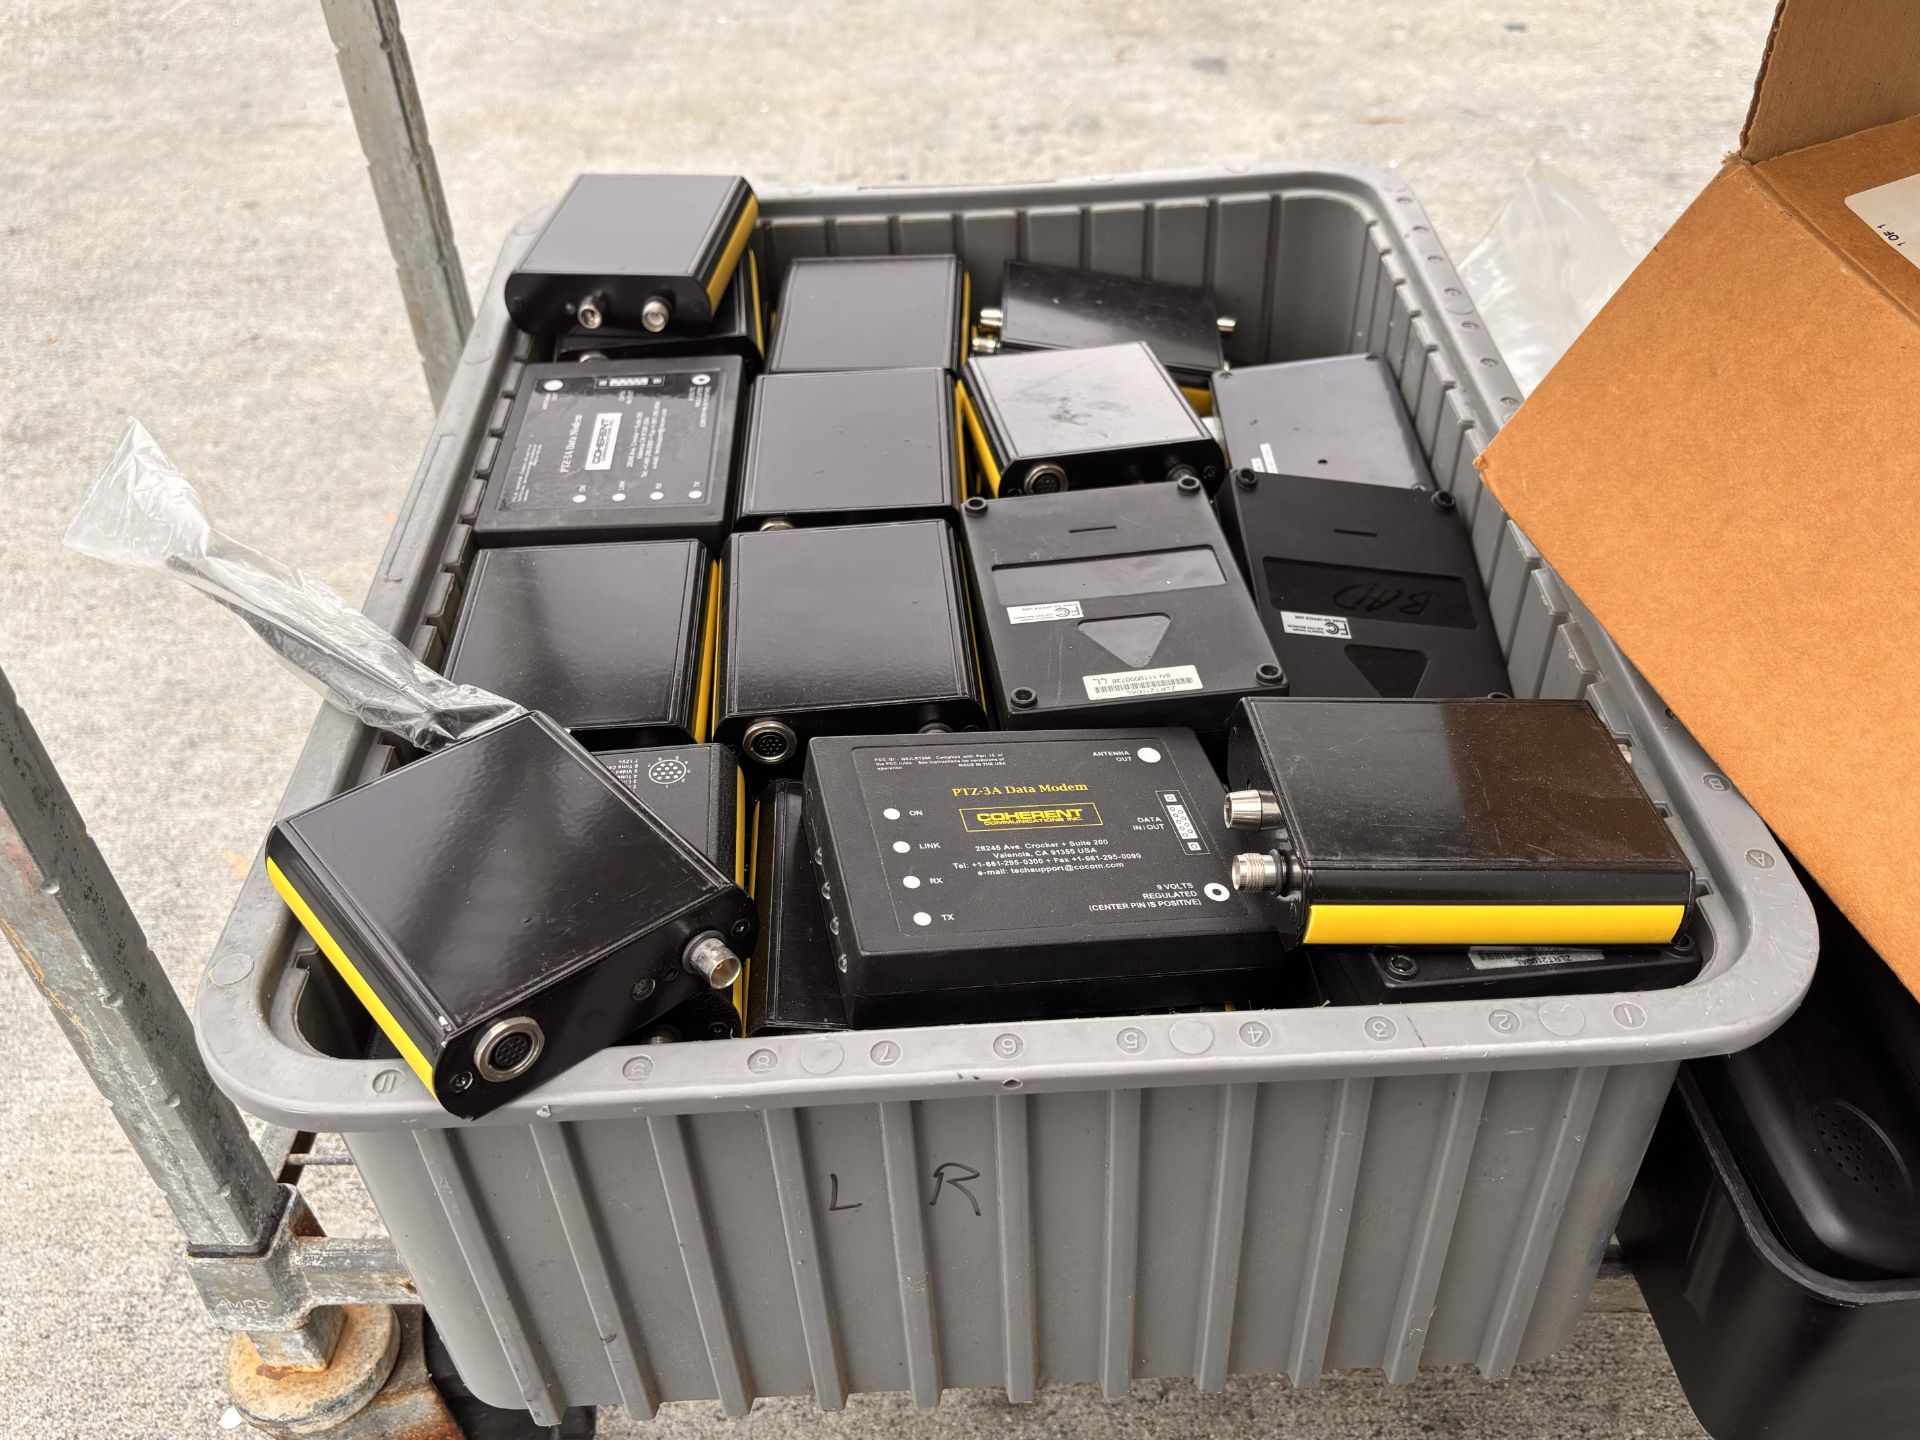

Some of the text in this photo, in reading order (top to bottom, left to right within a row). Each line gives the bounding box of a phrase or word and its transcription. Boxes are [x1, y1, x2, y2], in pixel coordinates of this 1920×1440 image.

[1883, 231, 1899, 241] OF
[592, 418, 610, 464] COHERENT
[1333, 582, 1437, 615] BAD
[952, 783, 1089, 797] PTZ-3A Data Modem
[1707, 778, 1725, 791] B
[976, 808, 1083, 822] COHERENT
[984, 817, 1064, 826] COMMUNICATIONS
[919, 842, 941, 850] LINK
[975, 844, 1002, 852] 28245
[1003, 843, 1022, 851] Ave.
[1024, 841, 1059, 849] Crocker
[1069, 839, 1091, 847] Suite
[992, 851, 1033, 859] Valencia,
[1750, 853, 1766, 867] A
[952, 862, 970, 870] Tel:
[1053, 856, 1070, 864] Fax
[977, 862, 1125, 876] e-mail: techsupport@cocom.com
[929, 877, 944, 885] RX
[1166, 882, 1194, 890] VOLTS
[1142, 890, 1198, 899] REGULATED
[1088, 898, 1202, 912] (CENTER PIN IS POSITIVE)
[941, 913, 955, 921] TX
[829, 1162, 981, 1216] L R
